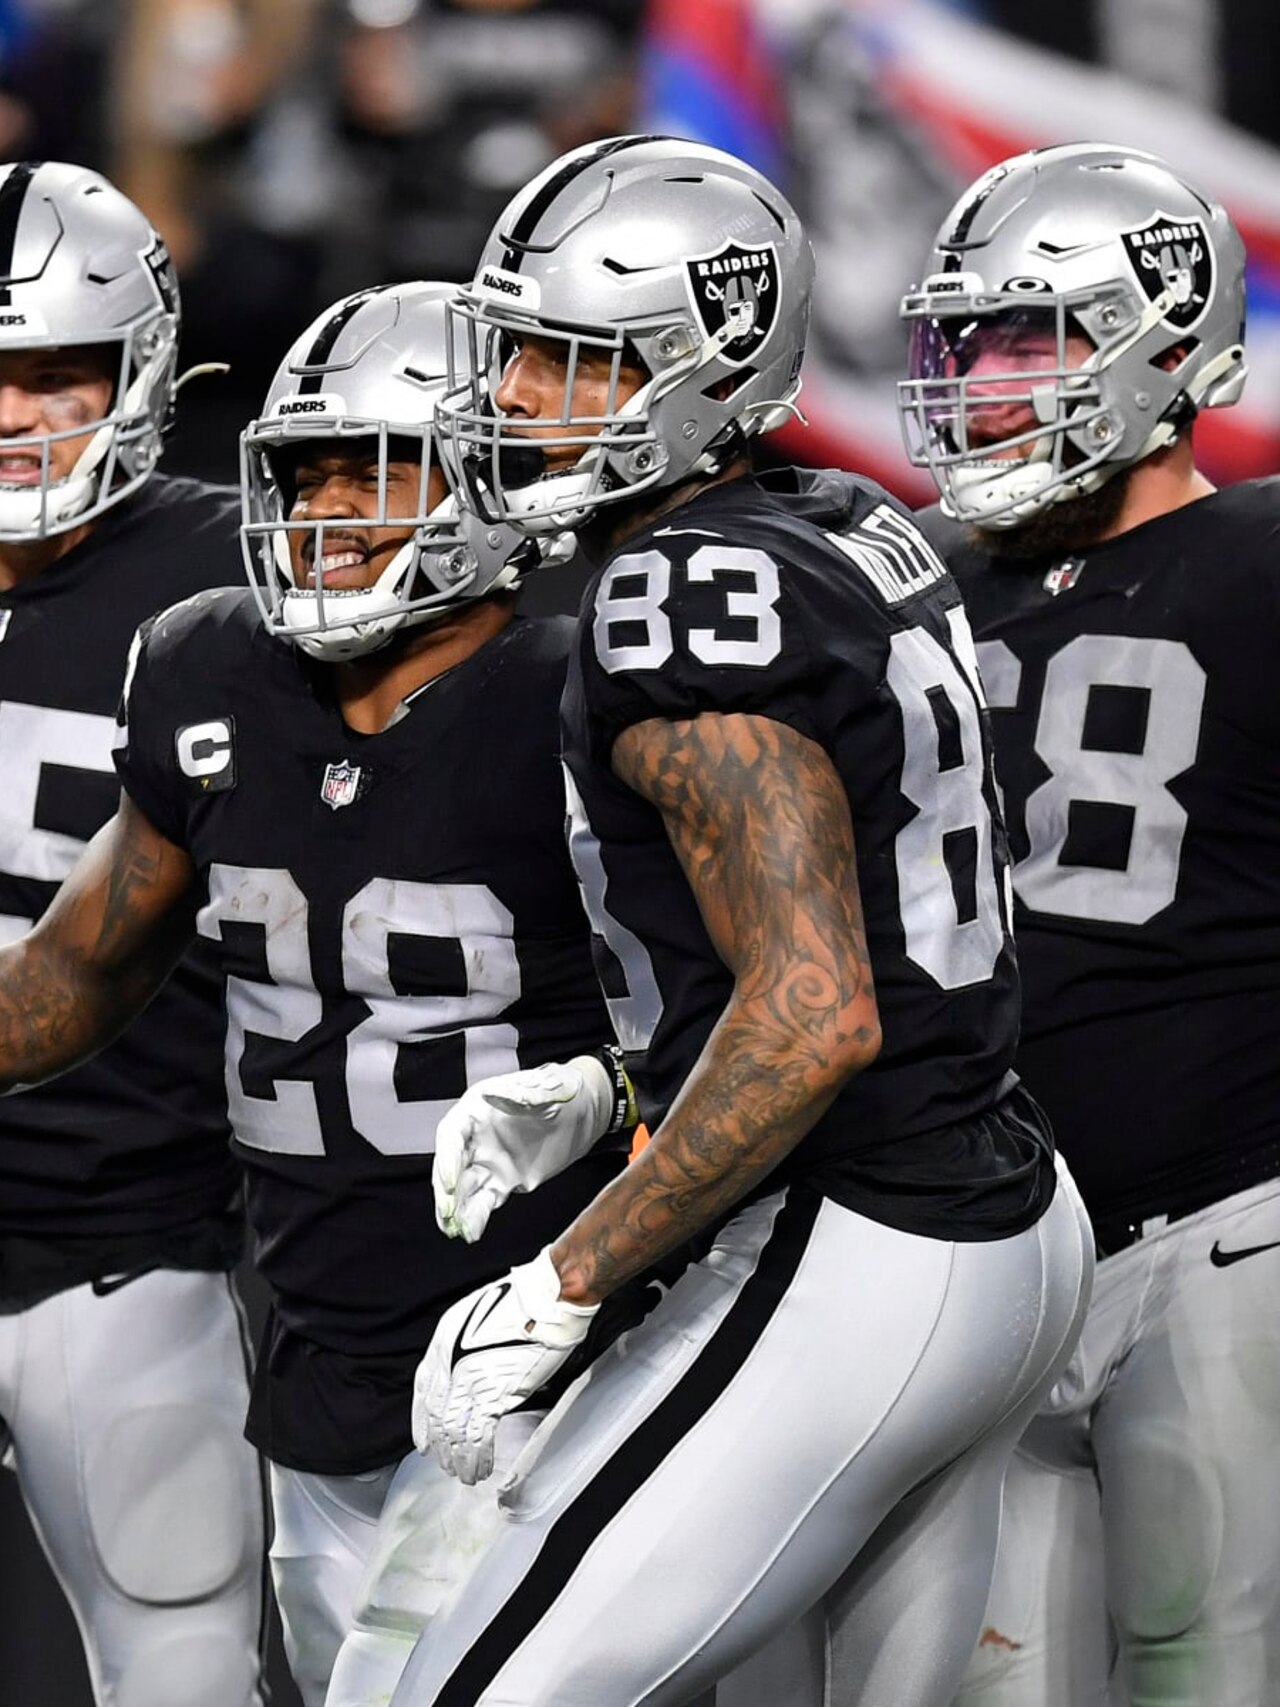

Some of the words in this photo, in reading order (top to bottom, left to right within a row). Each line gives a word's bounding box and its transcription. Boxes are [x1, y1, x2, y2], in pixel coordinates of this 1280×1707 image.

[1130, 224, 1200, 248] RAIDERS
[482, 273, 523, 297] RAIDERS
[697, 252, 769, 277] RAIDERS
[279, 400, 327, 416] RAIDERS
[593, 545, 782, 675] 83
[177, 721, 231, 778] C
[974, 633, 1208, 926] 8
[196, 862, 522, 1156] 28
